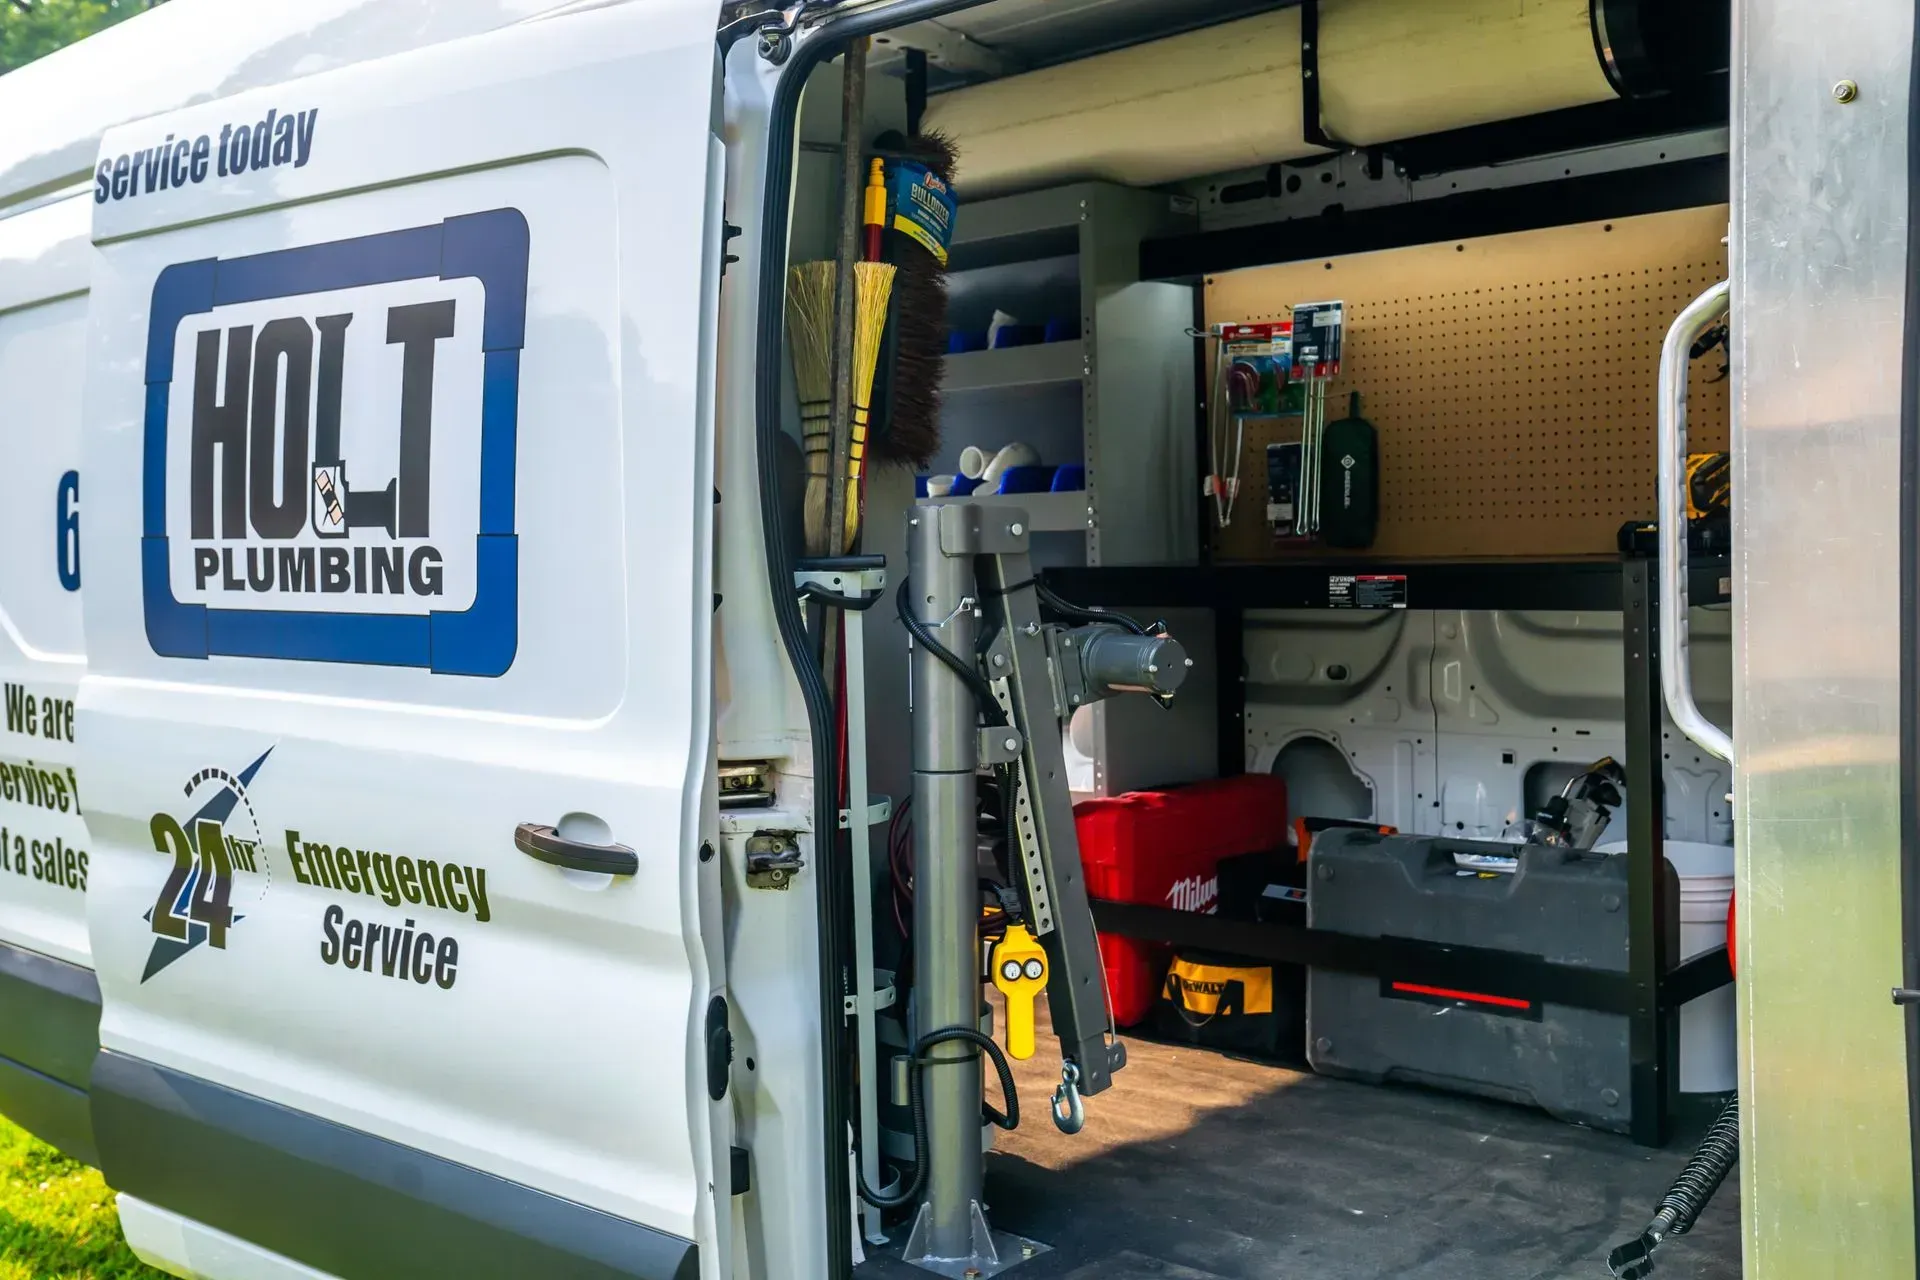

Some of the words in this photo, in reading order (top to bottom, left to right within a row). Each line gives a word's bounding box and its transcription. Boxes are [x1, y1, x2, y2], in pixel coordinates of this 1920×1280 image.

[95, 134, 210, 204] service
[217, 108, 318, 177] today
[191, 299, 456, 540] HOLT
[194, 546, 443, 596] PLUMBING
[4, 682, 37, 736] We
[42, 697, 75, 743] are
[0, 760, 70, 813] ervice
[14, 835, 27, 876] a
[31, 837, 89, 892] sales
[285, 829, 490, 922] Emergency
[1164, 874, 1218, 912] Milw
[321, 904, 459, 989] Service
